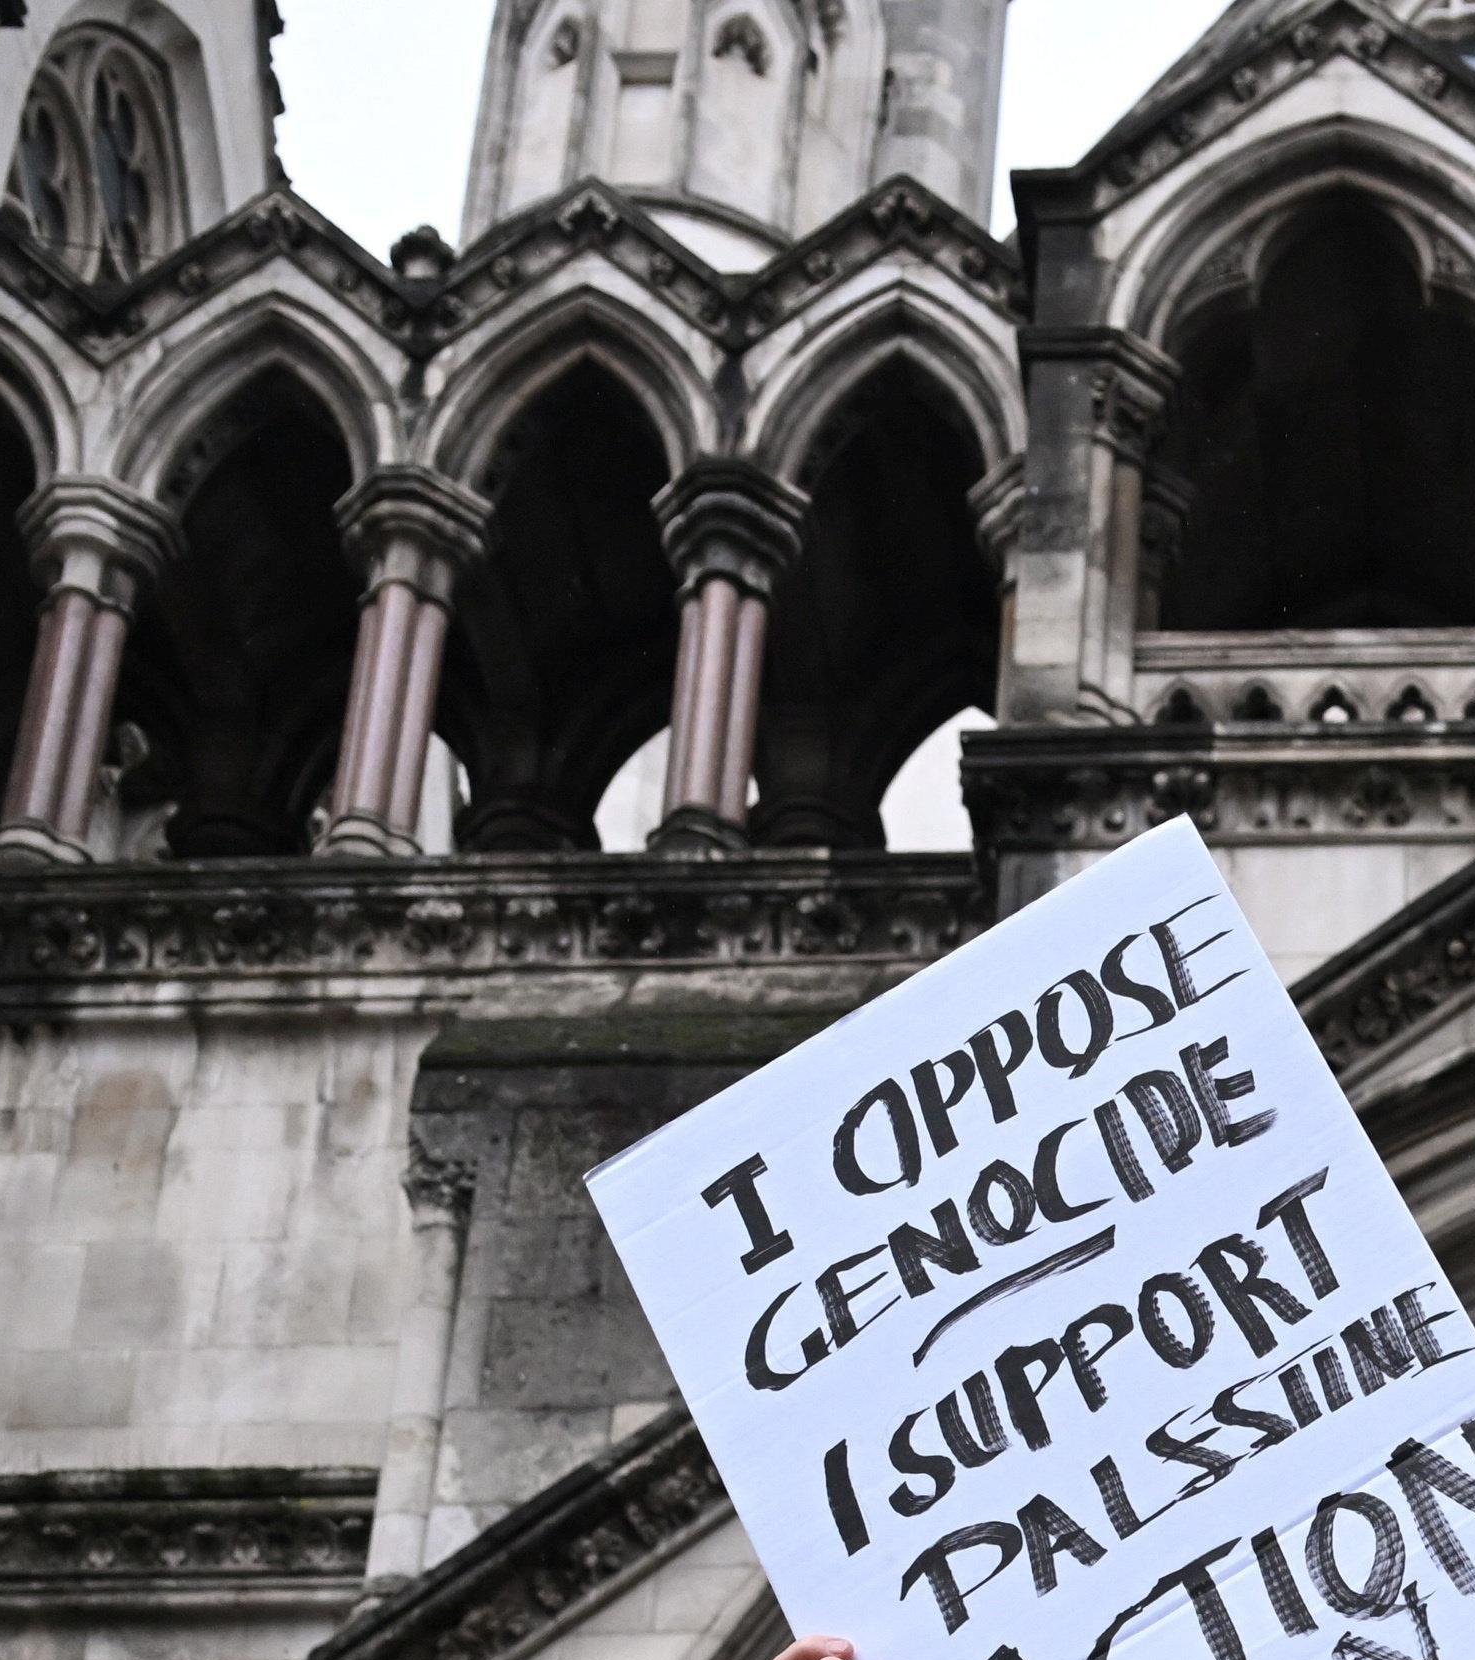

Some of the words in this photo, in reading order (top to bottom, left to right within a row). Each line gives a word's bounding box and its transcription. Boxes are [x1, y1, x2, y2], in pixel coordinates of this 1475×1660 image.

[701, 1152, 797, 1276] I
[832, 894, 1251, 1197] OPPOSE
[742, 1033, 1280, 1392] GENOCIDE
[822, 1438, 876, 1557] I
[887, 1166, 1339, 1519] SUPPORT
